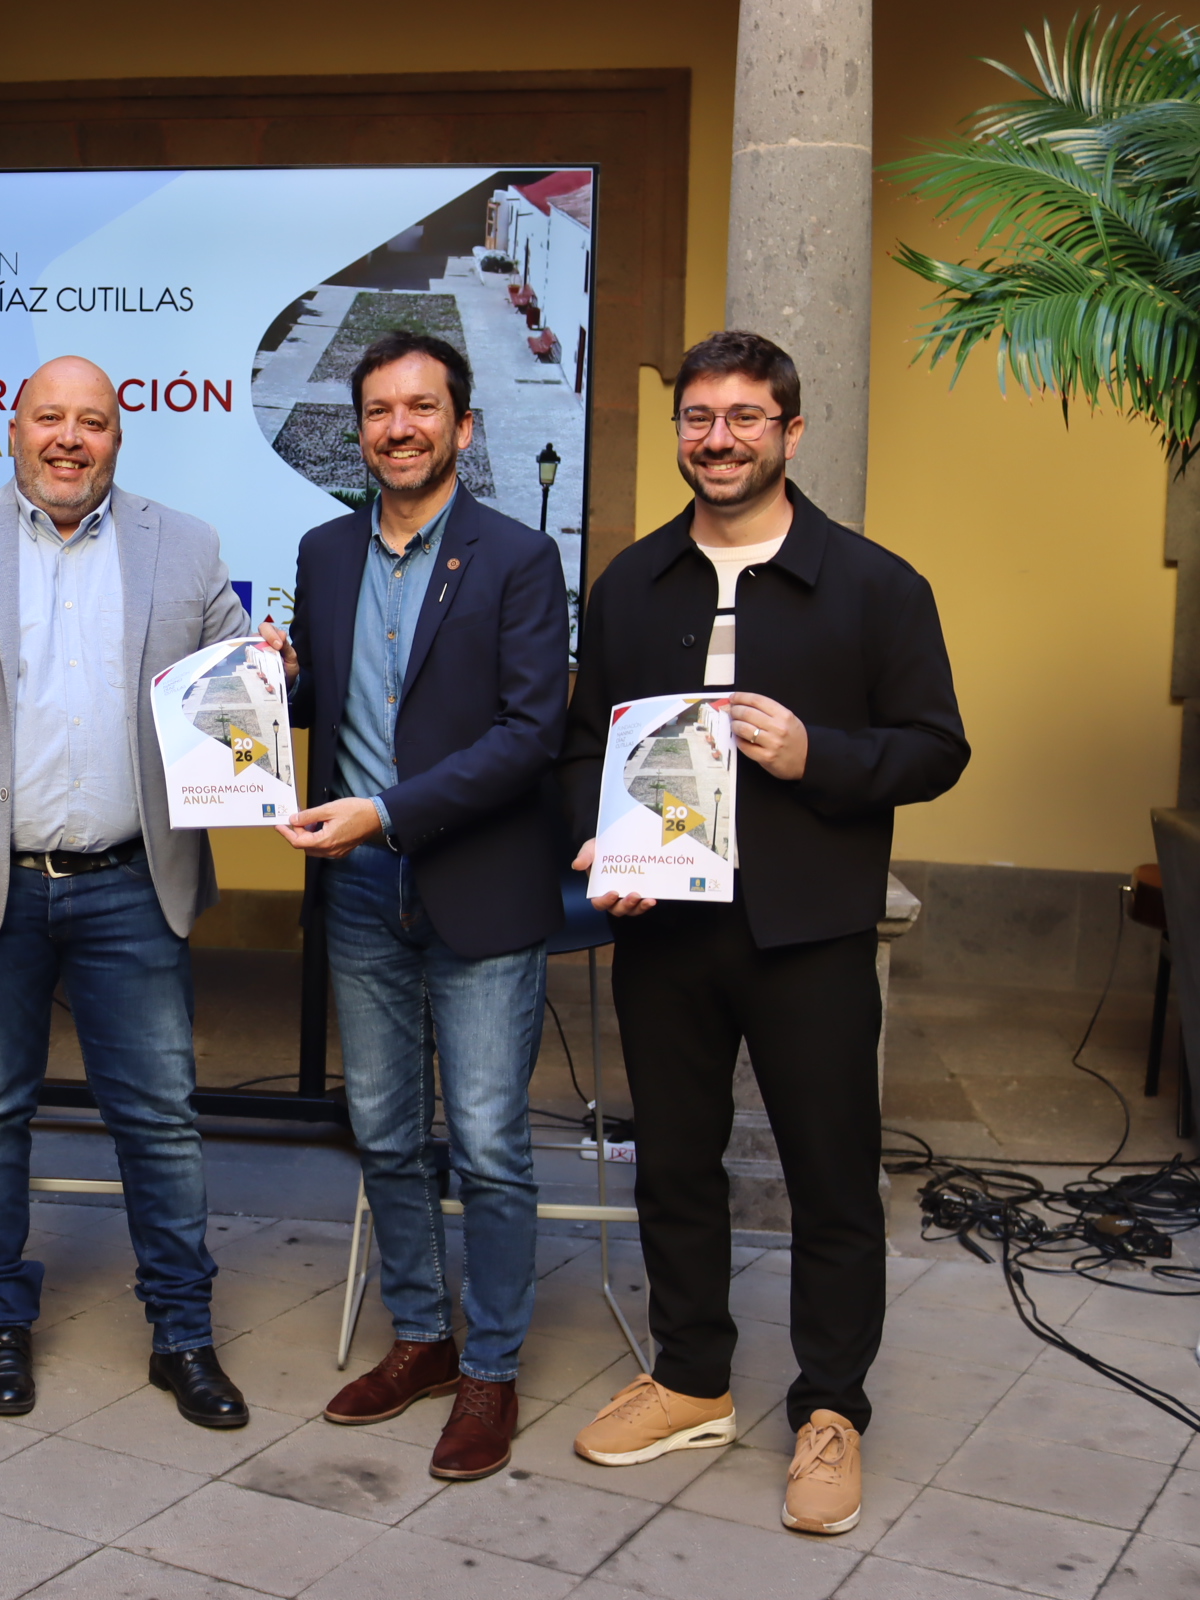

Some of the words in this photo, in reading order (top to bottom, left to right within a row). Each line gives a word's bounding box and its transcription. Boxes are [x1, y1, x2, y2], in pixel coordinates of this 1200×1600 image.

[56, 287, 194, 312] CUTILLAS
[233, 738, 253, 750] 20
[235, 750, 253, 762] 26
[182, 783, 264, 795] PROGRAMACIÓN
[183, 795, 224, 805] ANUAL
[665, 806, 688, 819] 20
[664, 819, 686, 832] 26
[602, 854, 694, 865] PROGRAMACIÓN
[600, 865, 645, 875] ANUAL
